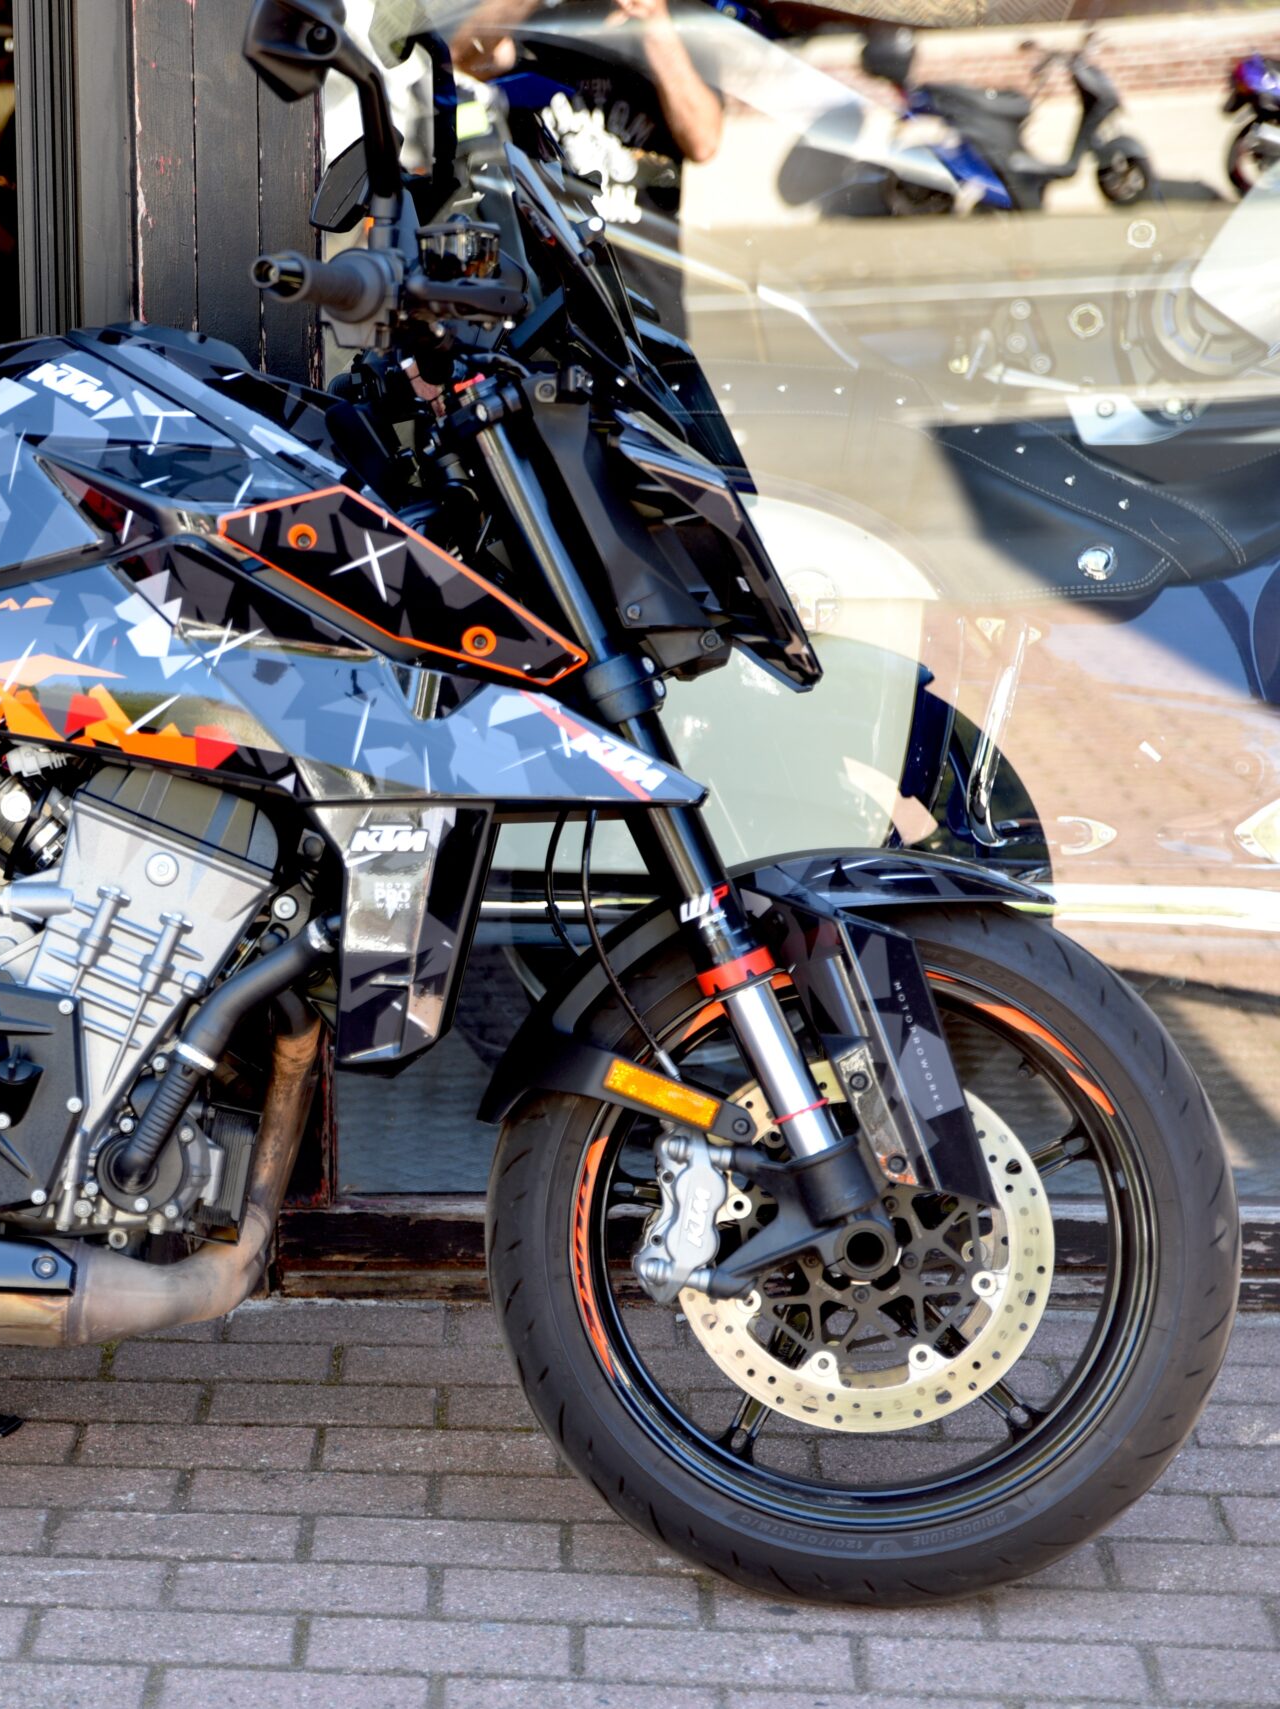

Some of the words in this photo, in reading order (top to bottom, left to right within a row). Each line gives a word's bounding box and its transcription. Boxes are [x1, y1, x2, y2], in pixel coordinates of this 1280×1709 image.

[26, 362, 115, 412] KTM
[570, 732, 668, 791] KTM
[350, 825, 428, 852] KTM
[680, 884, 728, 923] WP
[894, 981, 943, 1112] MOTOPROWORKS
[684, 1186, 712, 1249] KTM
[912, 1510, 1007, 1547] BRIDGESTONE
